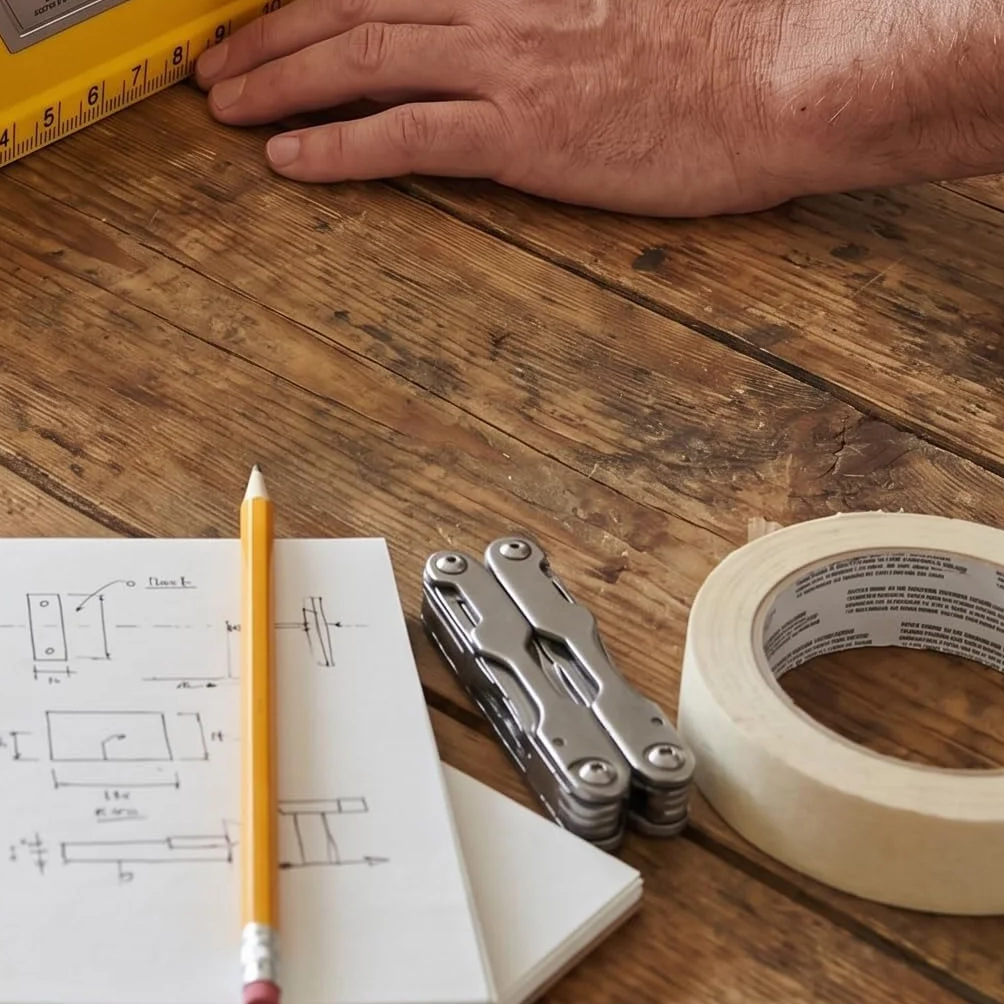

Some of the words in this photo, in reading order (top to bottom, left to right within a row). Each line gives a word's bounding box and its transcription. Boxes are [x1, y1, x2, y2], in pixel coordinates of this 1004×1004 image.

[44, 107, 55, 128] 5
[87, 86, 99, 106] 6
[131, 65, 142, 86] 7
[172, 46, 183, 65] 8
[215, 25, 225, 44] 9
